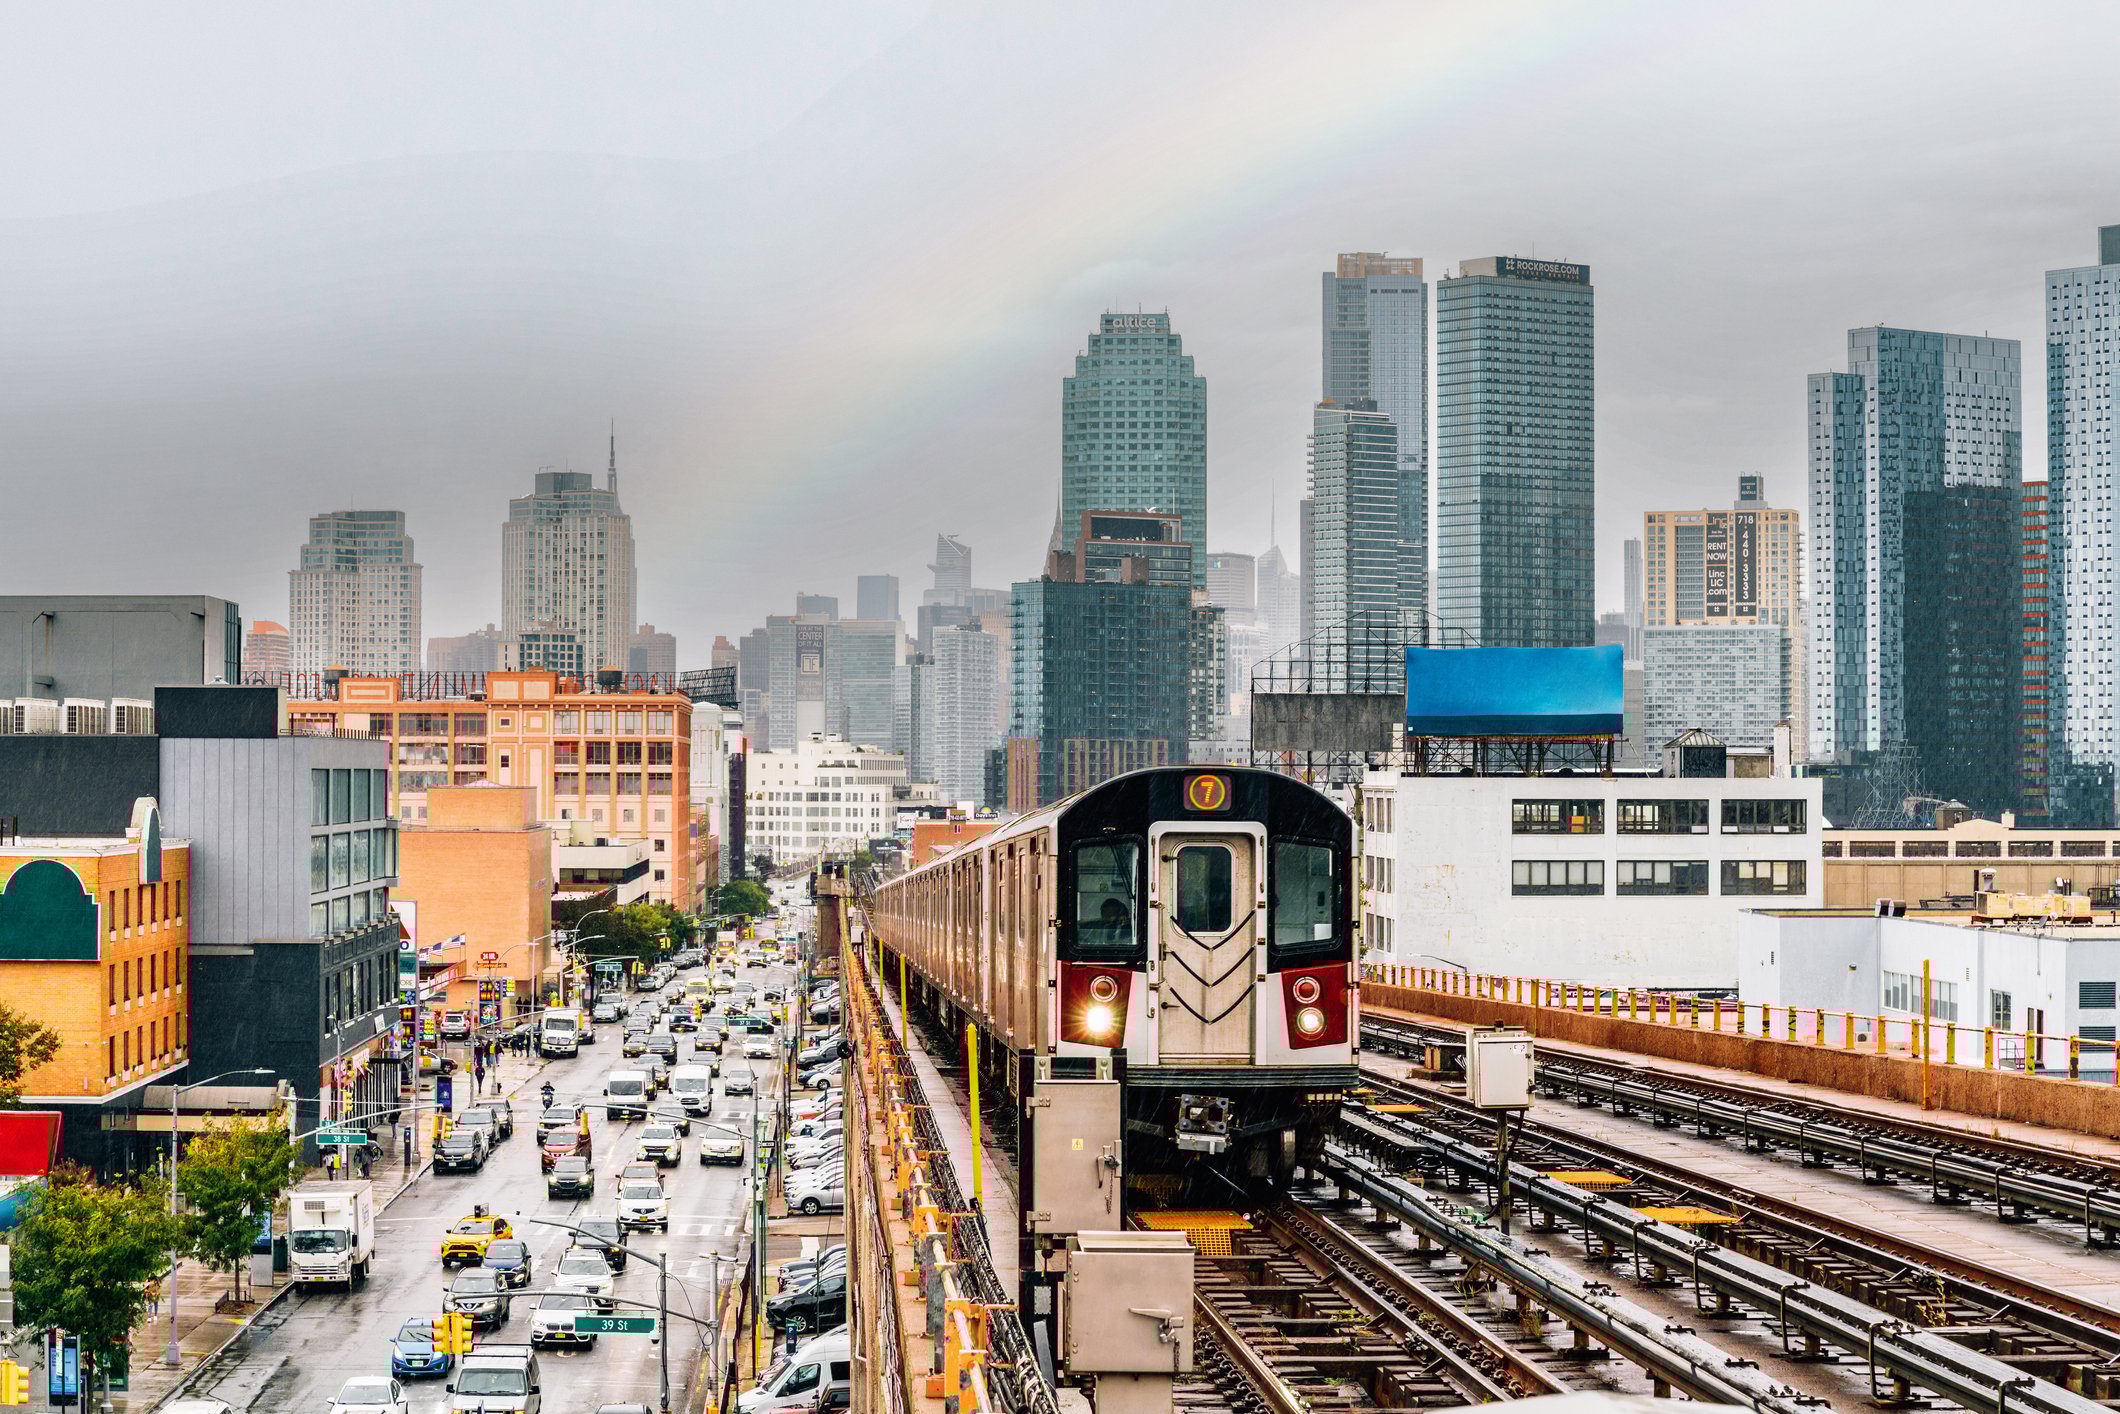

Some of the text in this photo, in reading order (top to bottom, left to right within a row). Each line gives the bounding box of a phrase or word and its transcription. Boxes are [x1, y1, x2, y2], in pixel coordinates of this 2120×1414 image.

[1517, 261, 1579, 274] ROCKROSE.COM
[1112, 315, 1156, 328] altice
[1738, 515, 1754, 524] 718
[1707, 542, 1727, 550] RENT
[1707, 552, 1727, 561] NOW
[1708, 570, 1726, 578] Linc
[1710, 579, 1724, 587] LIC
[1707, 588, 1728, 596] .com
[798, 631, 823, 640] CENTER
[1200, 781, 1214, 803] 7
[481, 992, 499, 1000] WAH
[601, 1319, 628, 1330] 39 St
